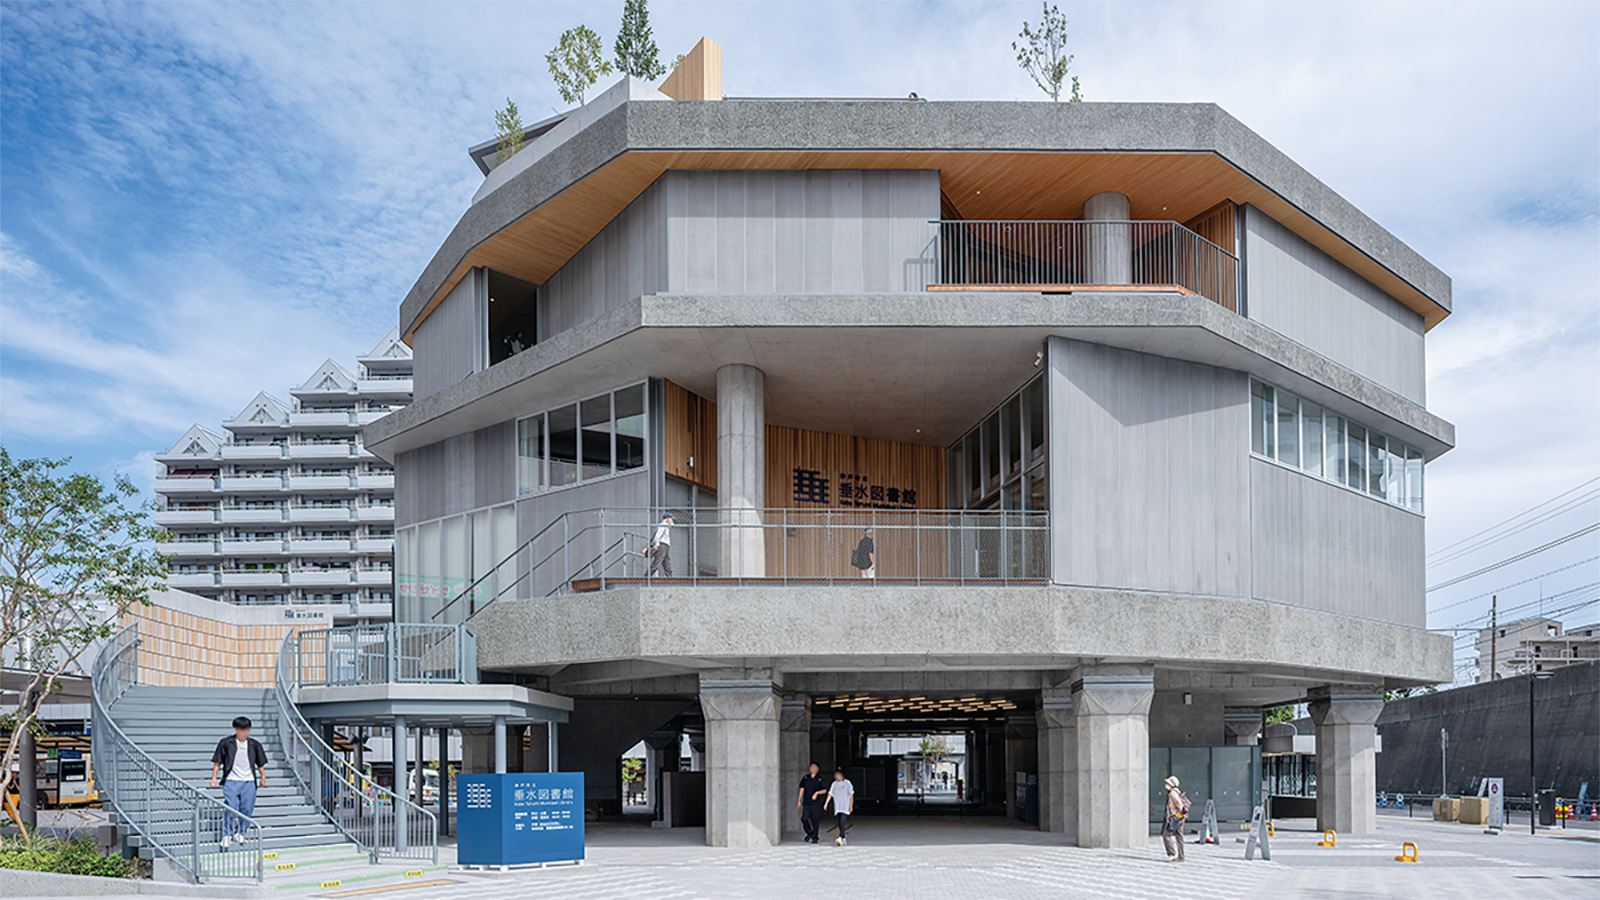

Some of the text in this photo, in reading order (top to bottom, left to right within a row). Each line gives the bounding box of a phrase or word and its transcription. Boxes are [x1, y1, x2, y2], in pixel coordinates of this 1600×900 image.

[839, 482, 917, 505] 垂水図書館
[514, 788, 574, 801] 垂水図書館
